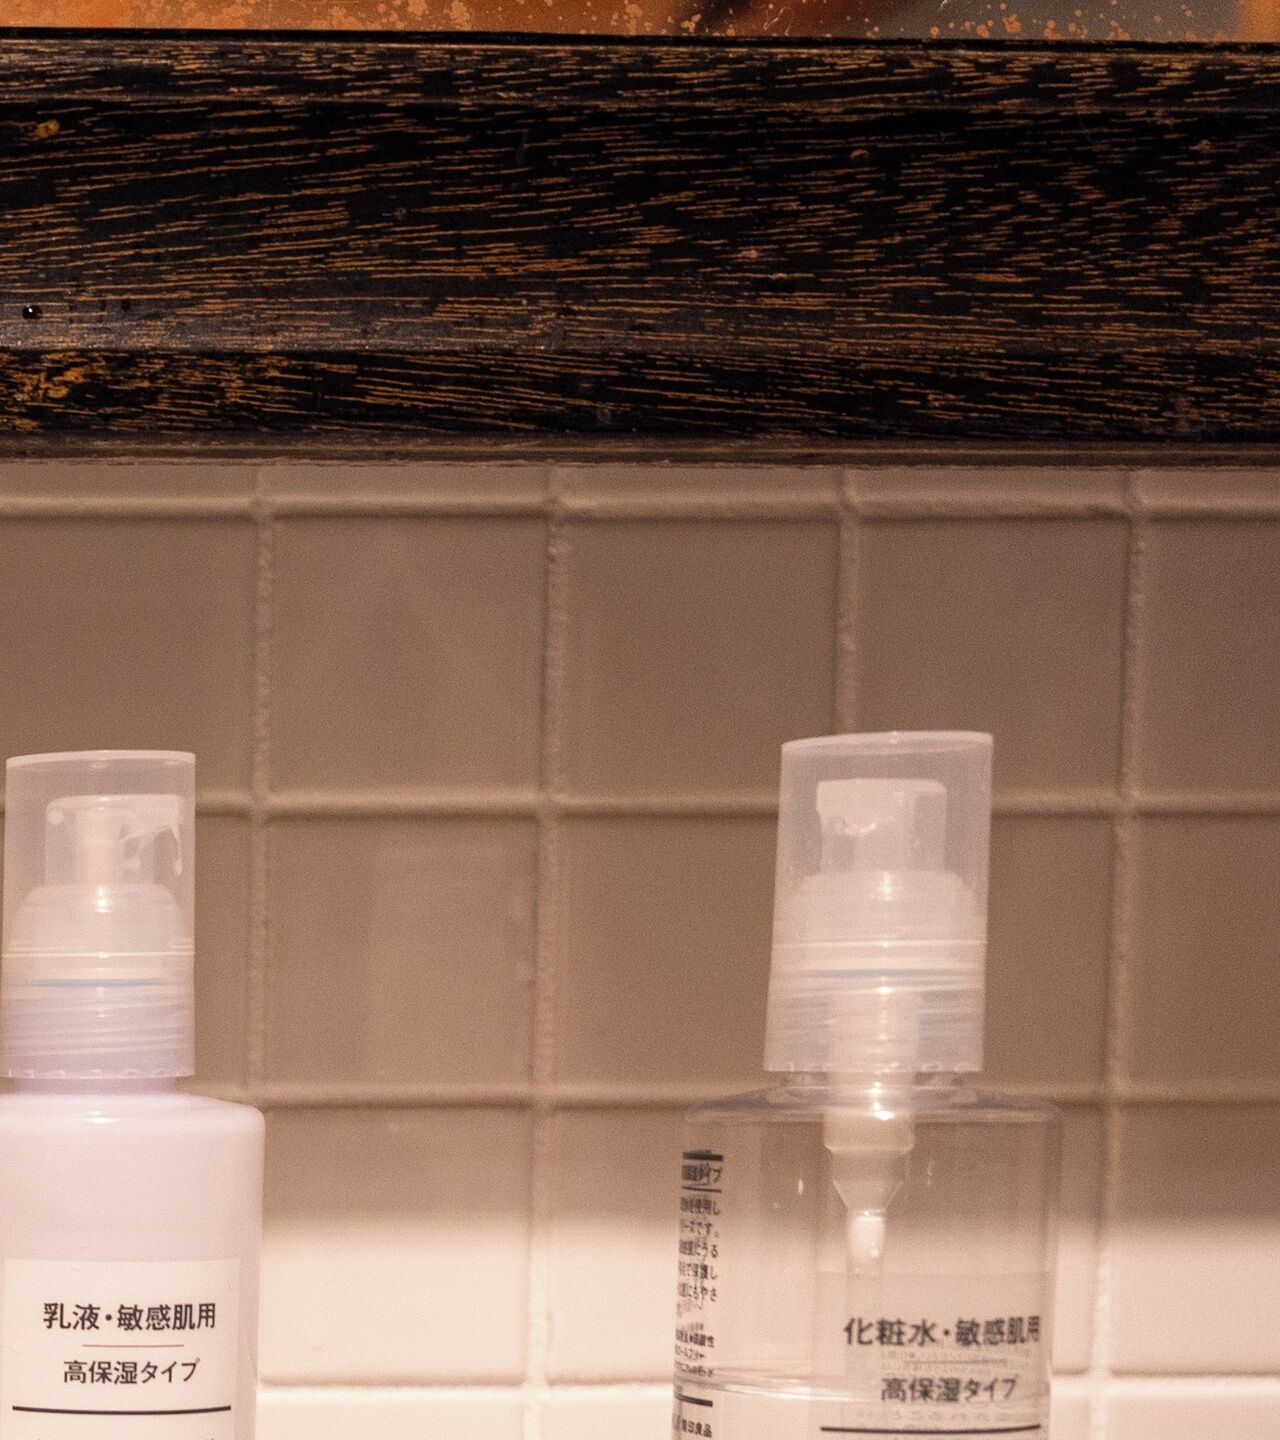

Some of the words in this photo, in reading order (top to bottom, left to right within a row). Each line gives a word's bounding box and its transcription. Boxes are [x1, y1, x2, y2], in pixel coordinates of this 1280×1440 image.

[43, 1302, 216, 1331] 乳液・敏感肌用
[843, 1315, 1040, 1347] 化粧水・敏感肌用
[64, 1357, 200, 1385] 高保湿タイプ
[880, 1376, 1017, 1403] 高保湿タイプ
